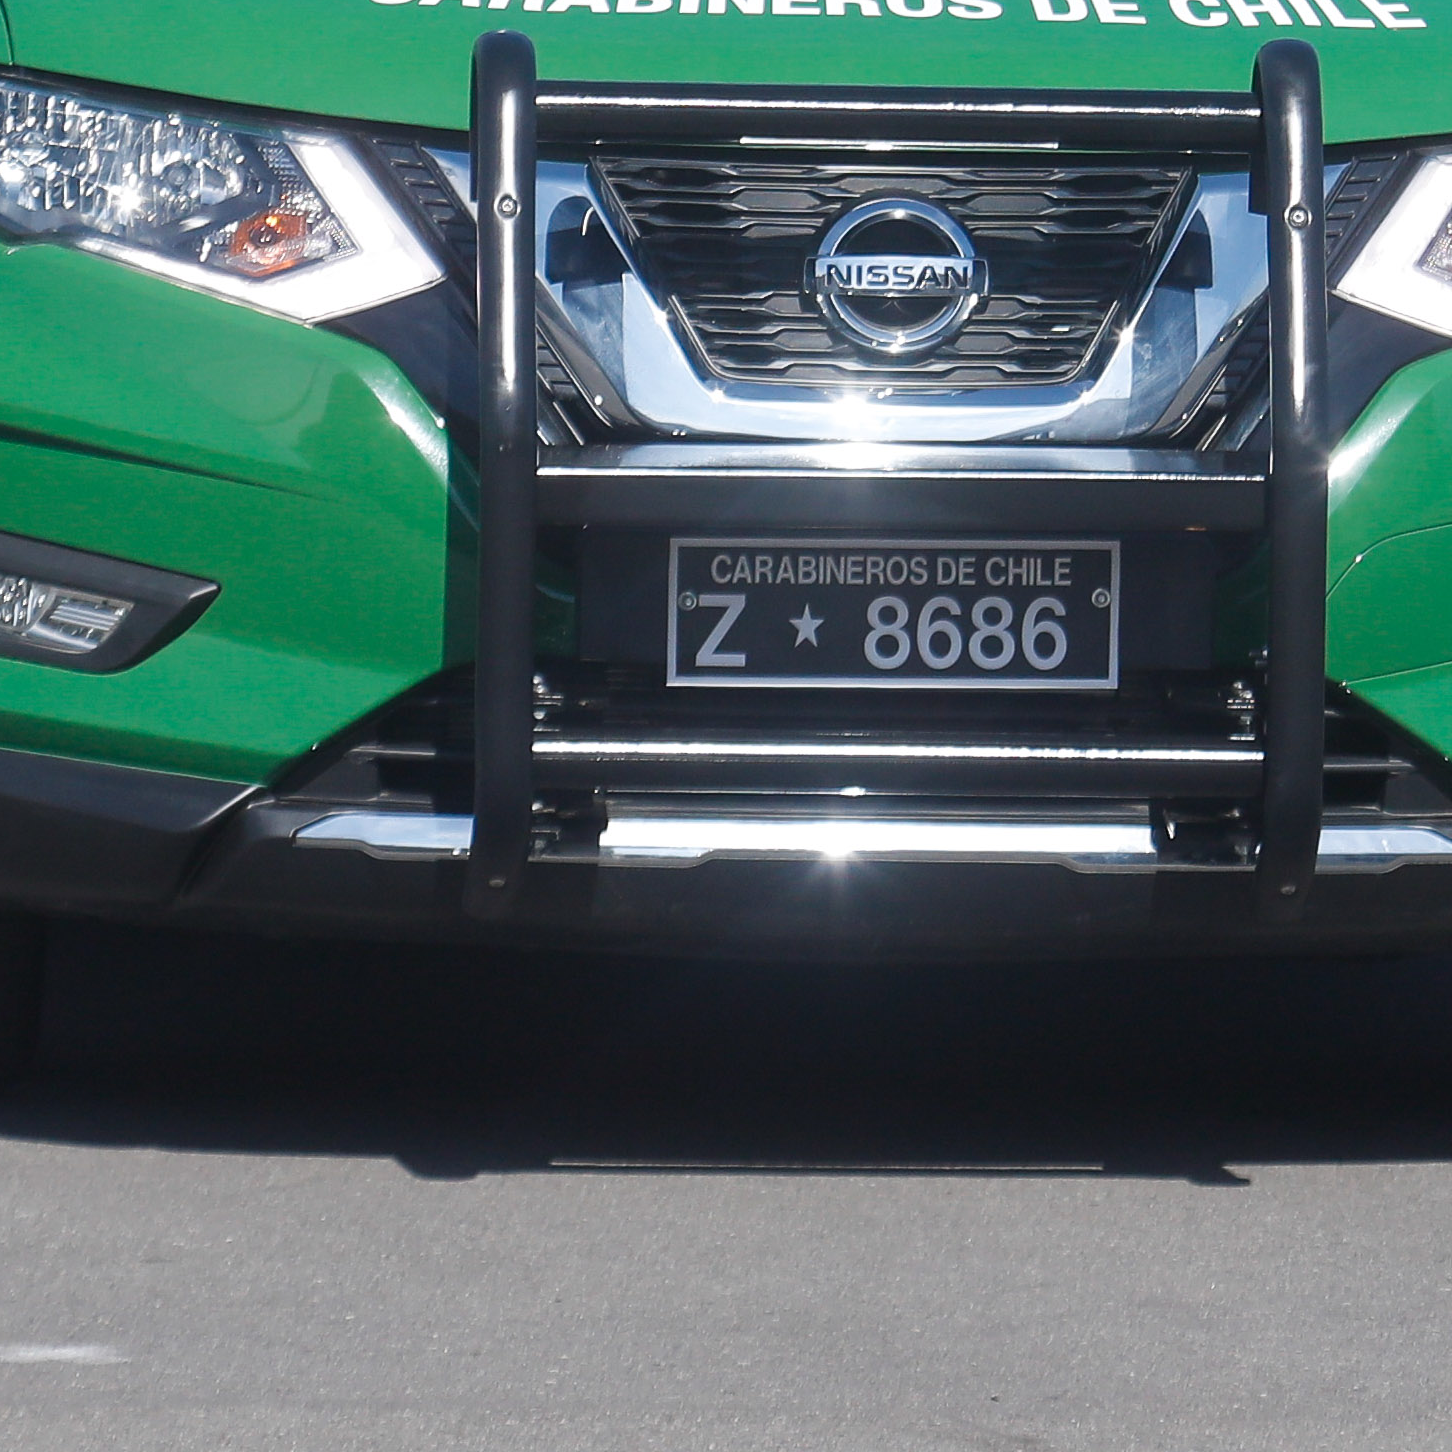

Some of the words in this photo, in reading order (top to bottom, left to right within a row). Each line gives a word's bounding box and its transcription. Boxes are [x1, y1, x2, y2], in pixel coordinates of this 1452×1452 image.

[824, 263, 971, 289] NISSAN
[710, 554, 928, 586] CARABINEROS
[936, 557, 977, 586] DE
[984, 557, 1072, 587] CHILE
[694, 593, 747, 667] Z
[863, 595, 1068, 670] 8686
